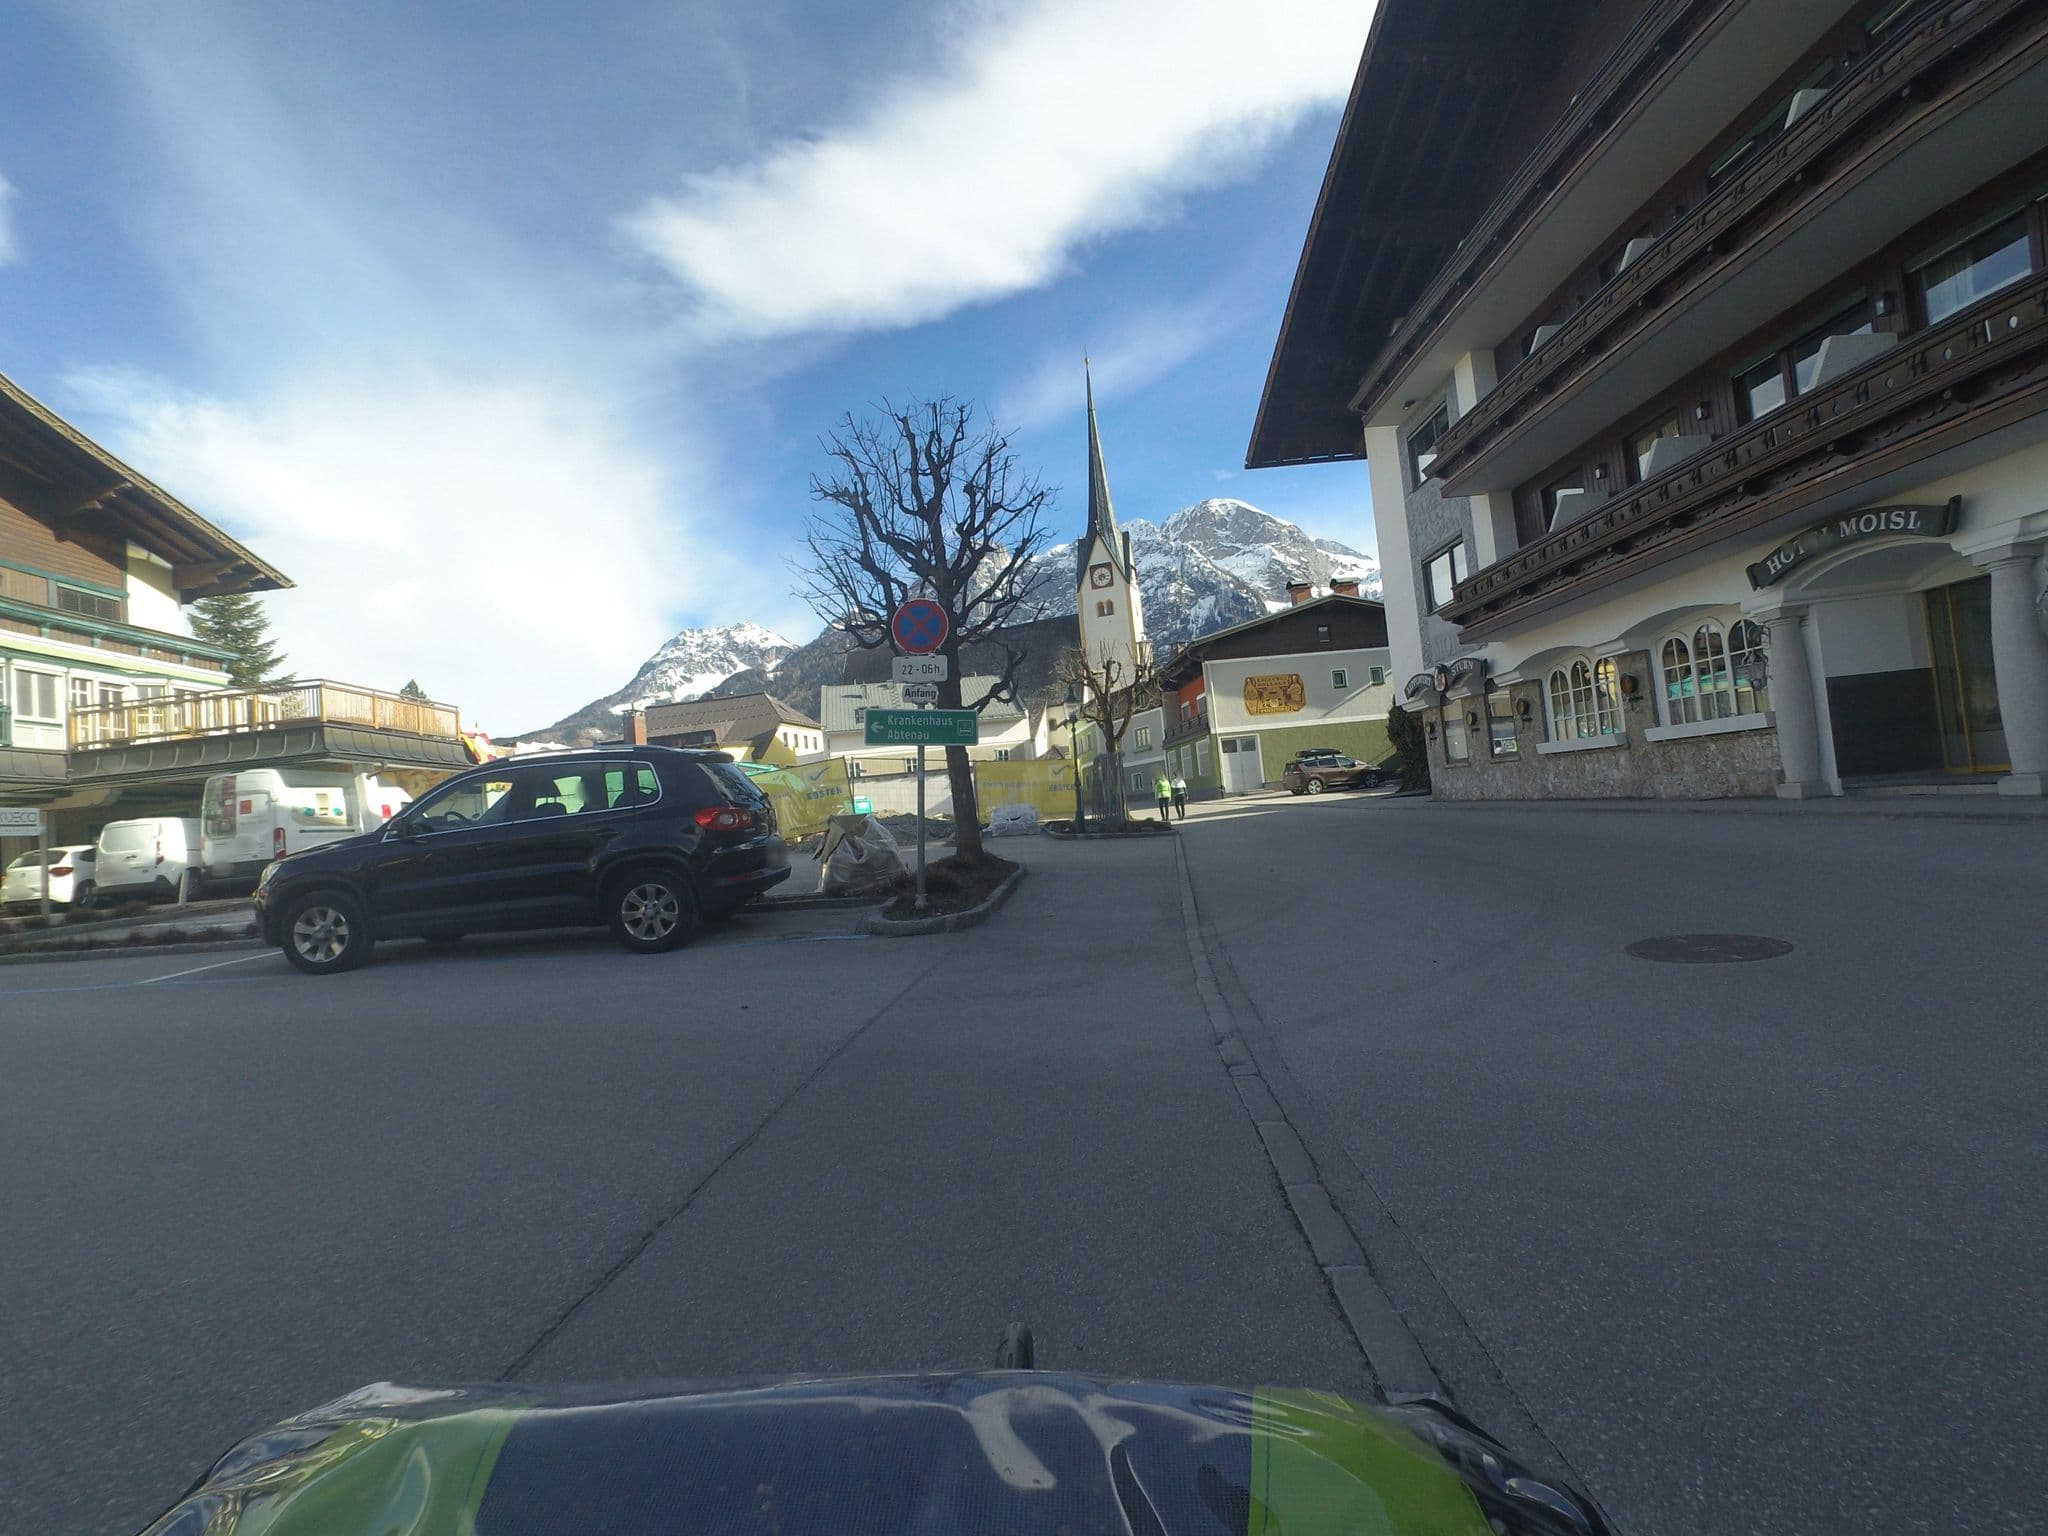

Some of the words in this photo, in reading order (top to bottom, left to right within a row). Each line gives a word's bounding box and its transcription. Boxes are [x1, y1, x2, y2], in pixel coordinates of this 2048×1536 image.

[1839, 510, 1921, 538] MOISL
[904, 688, 936, 700] Anfang
[887, 715, 953, 726] Krankenhaus
[887, 729, 929, 740] Abtenau
